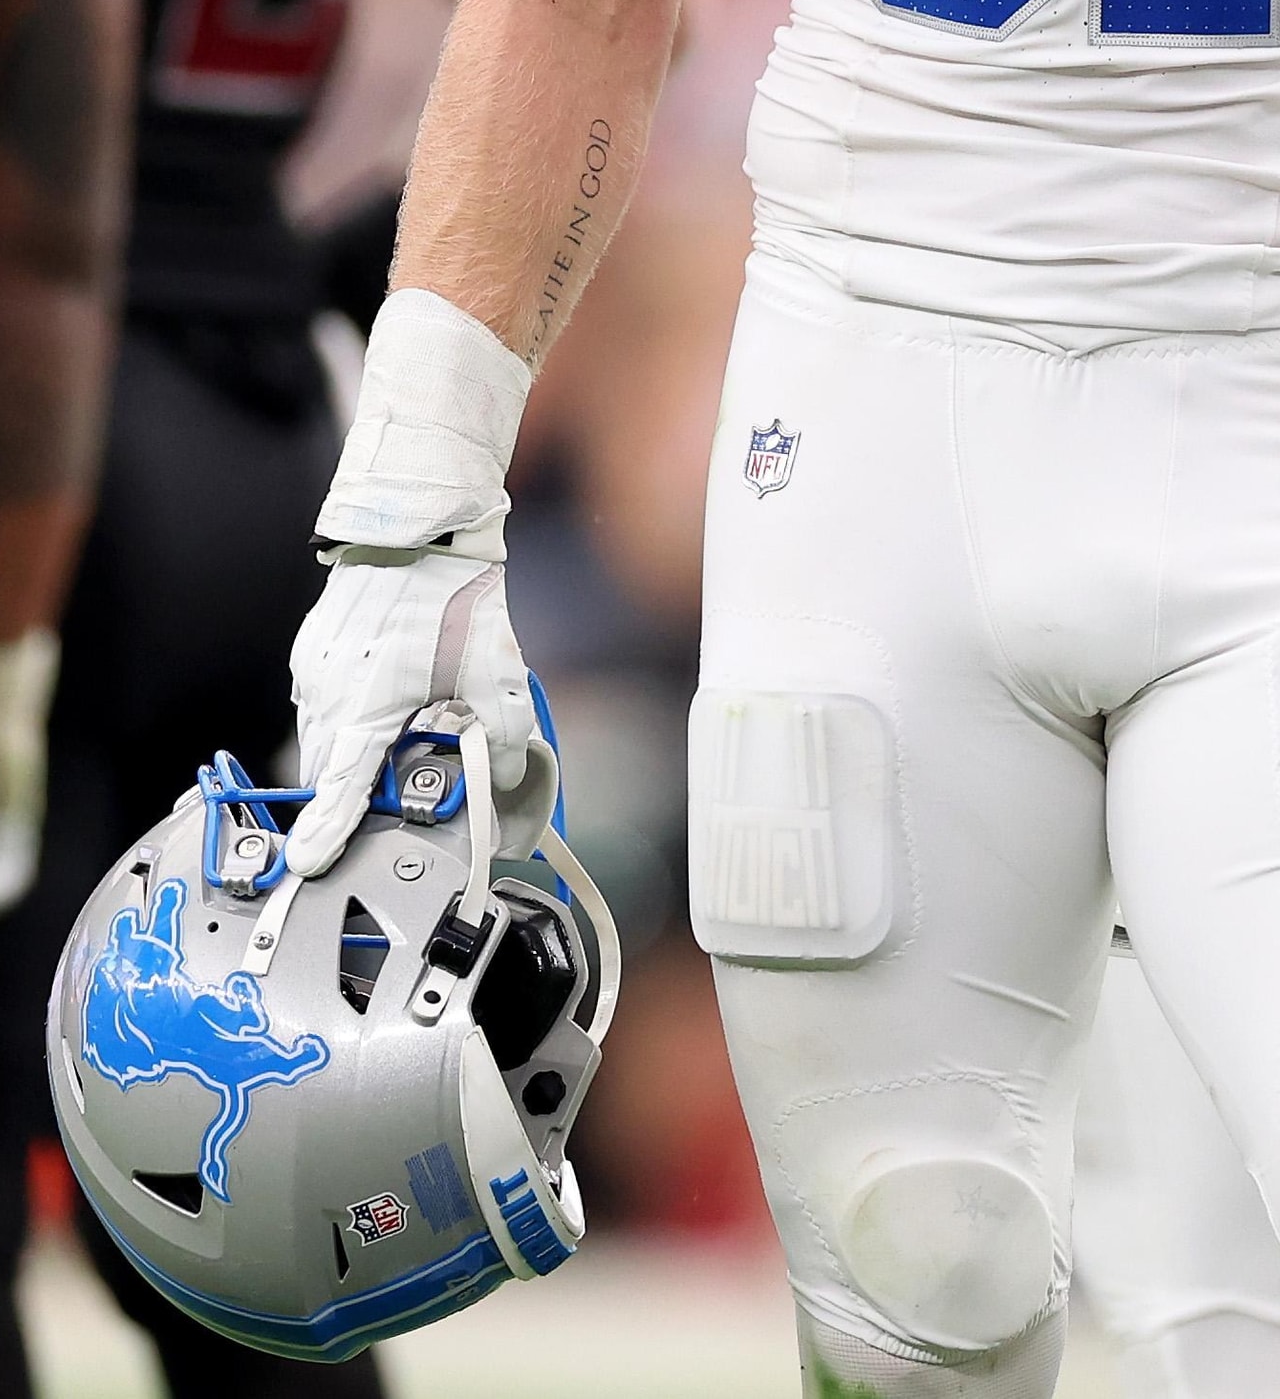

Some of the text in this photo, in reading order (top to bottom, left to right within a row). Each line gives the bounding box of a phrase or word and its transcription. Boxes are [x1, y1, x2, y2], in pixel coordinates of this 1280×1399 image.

[565, 204, 592, 247] IN
[579, 118, 612, 199] GOD
[749, 453, 782, 481] NFL
[372, 1198, 401, 1234] NFL
